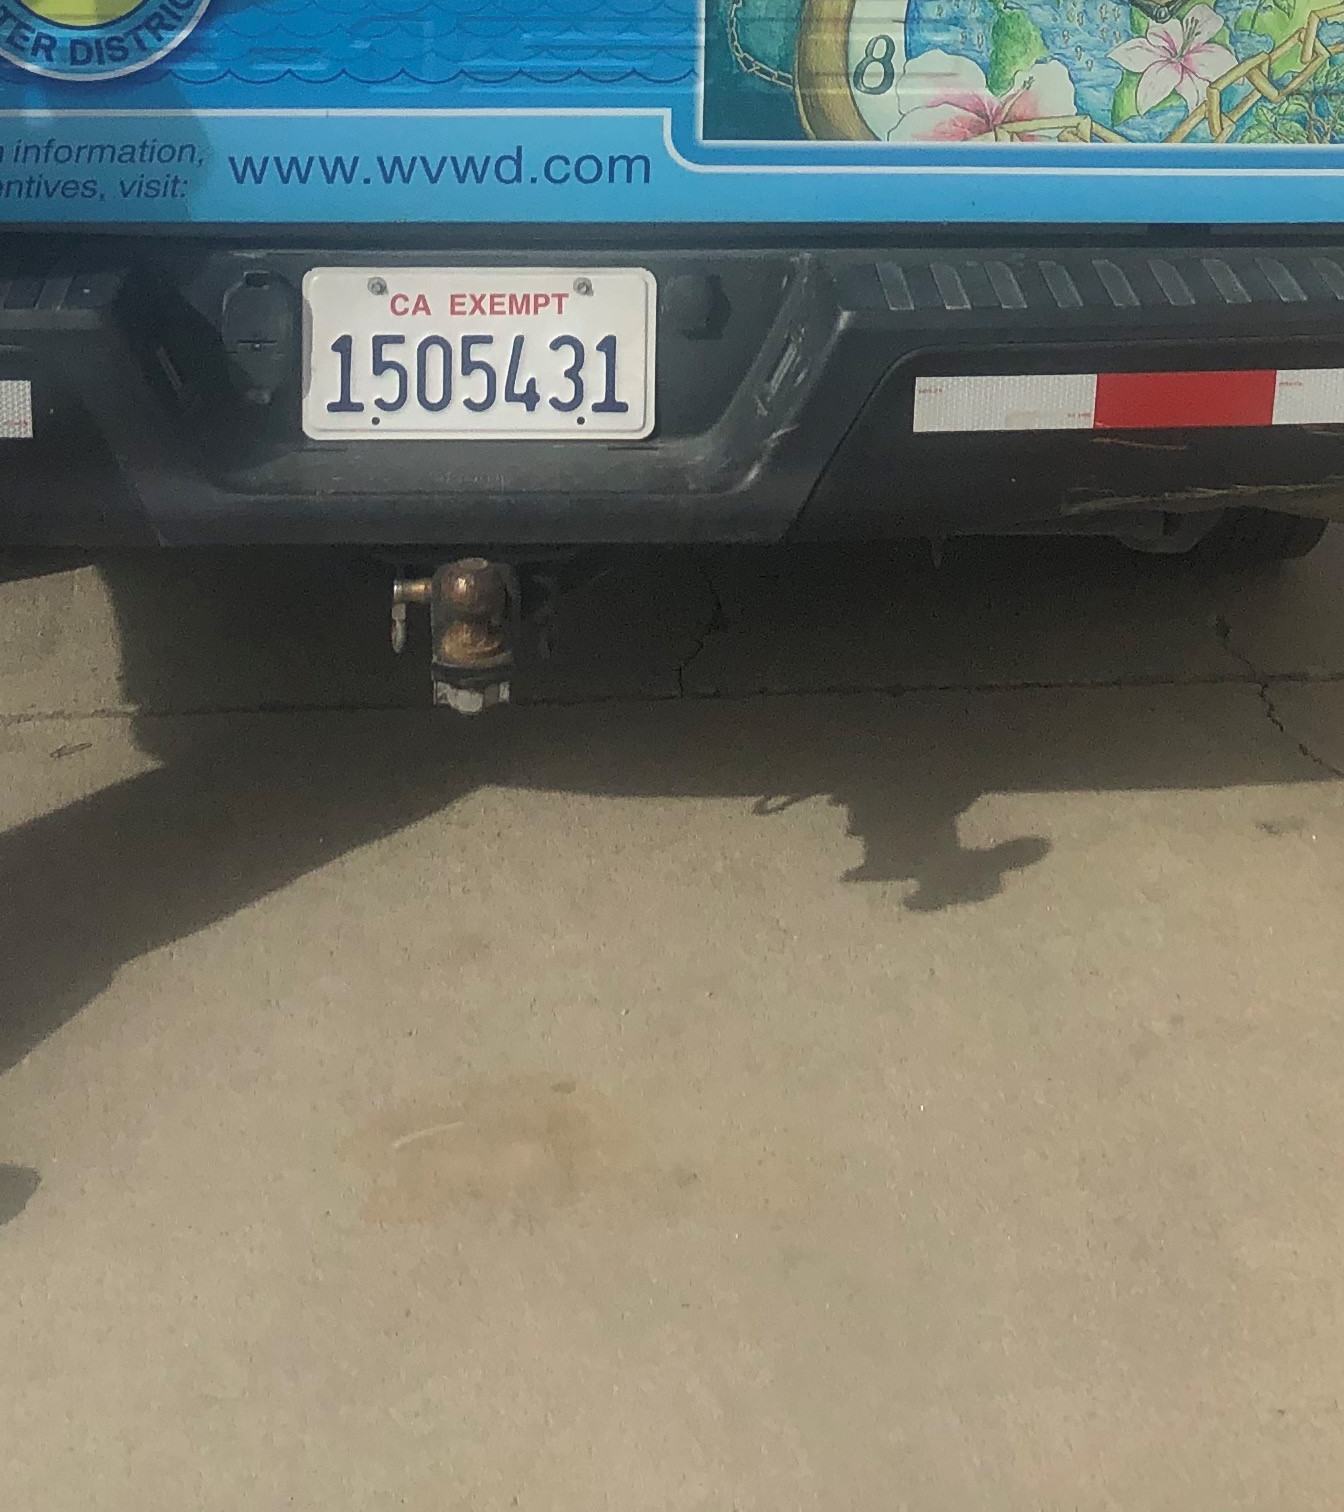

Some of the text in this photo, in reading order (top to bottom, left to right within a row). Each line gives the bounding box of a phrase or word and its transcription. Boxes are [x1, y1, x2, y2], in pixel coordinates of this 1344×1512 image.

[856, 35, 895, 95] 8
[13, 139, 205, 169] information,
[228, 145, 651, 185] www.wvwd.com
[118, 175, 188, 201] visit:
[390, 293, 569, 316] CA EXEMPT
[326, 334, 629, 413] 1505431
